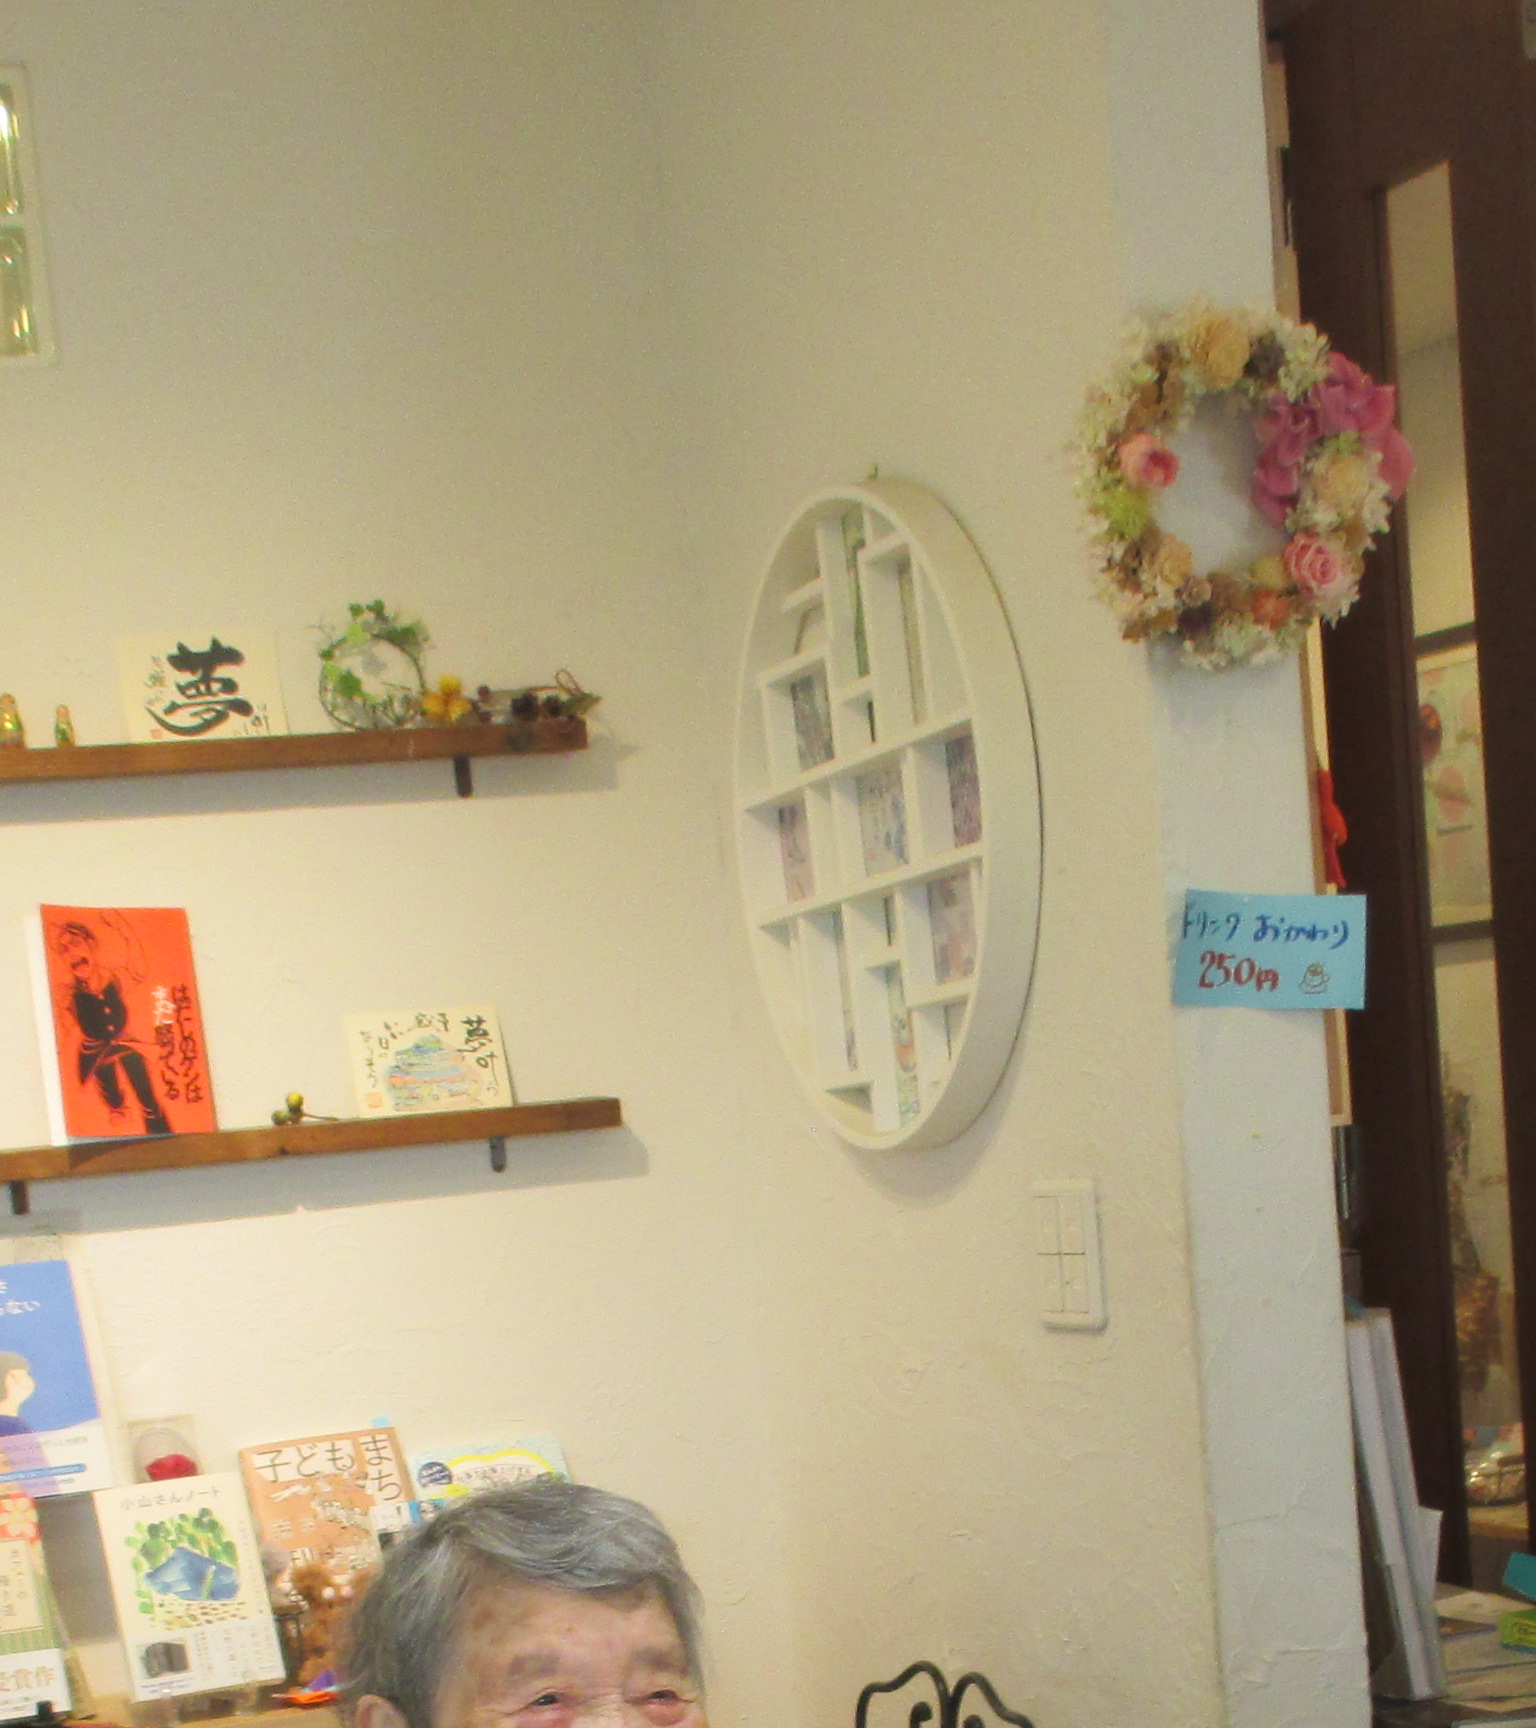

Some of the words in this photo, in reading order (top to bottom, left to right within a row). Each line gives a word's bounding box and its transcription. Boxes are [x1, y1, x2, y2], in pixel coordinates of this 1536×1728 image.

[145, 635, 255, 736] 夢
[1253, 914, 1350, 950] おかわり
[1197, 949, 1281, 992] 250円
[254, 1440, 356, 1482] 子ども
